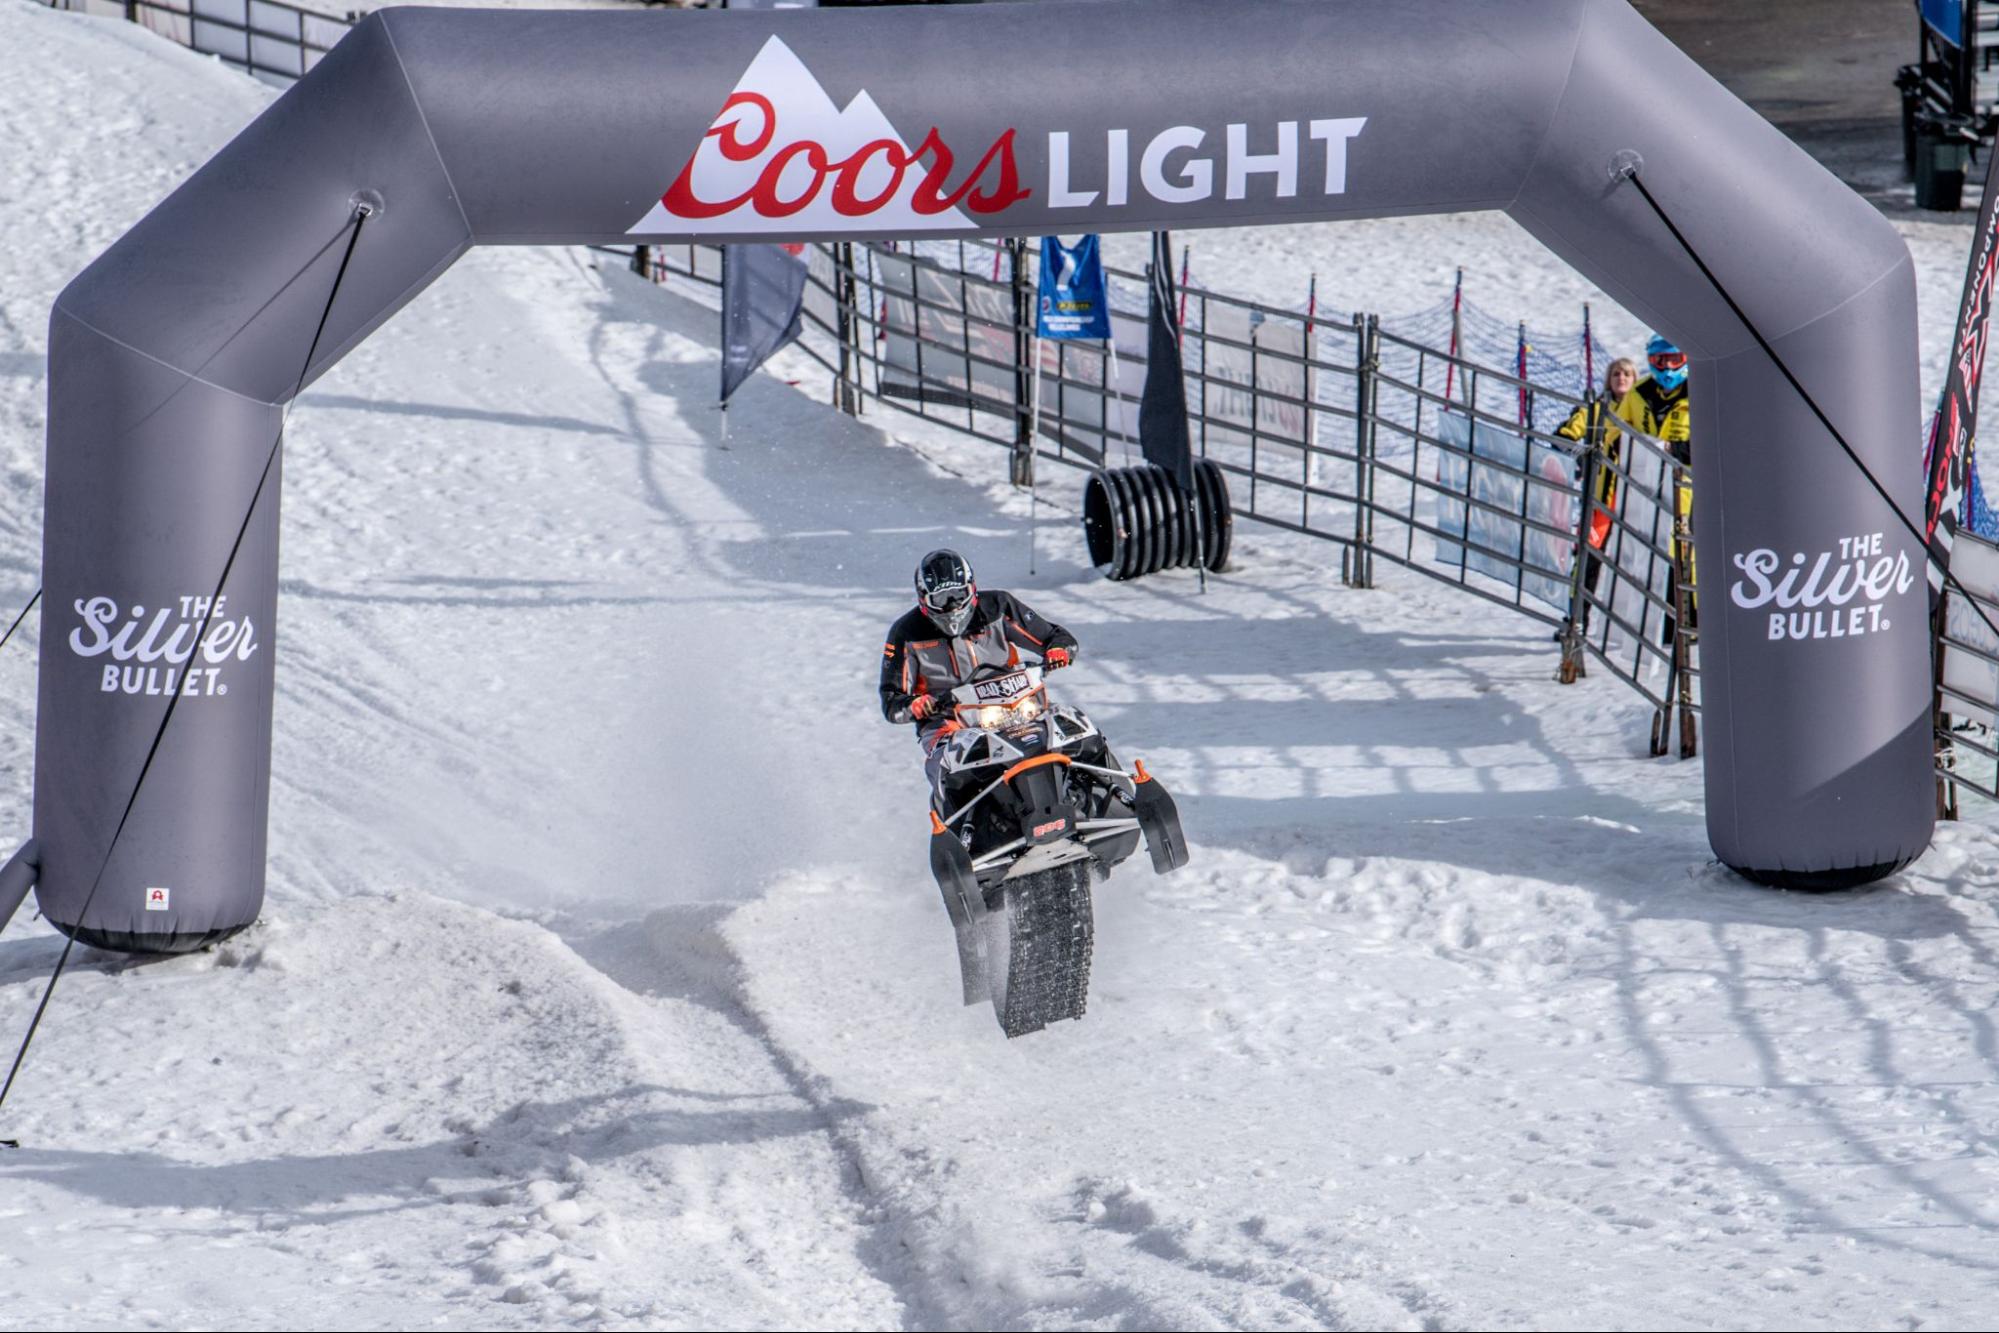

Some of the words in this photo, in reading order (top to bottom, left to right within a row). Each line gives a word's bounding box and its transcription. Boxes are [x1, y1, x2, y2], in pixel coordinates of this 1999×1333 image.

[661, 92, 1032, 219] Coors
[1048, 117, 1367, 208] LIGHT
[1839, 533, 1883, 559] THE
[180, 595, 227, 618] THE
[1731, 549, 1914, 609] Silver
[69, 596, 257, 663] Silver
